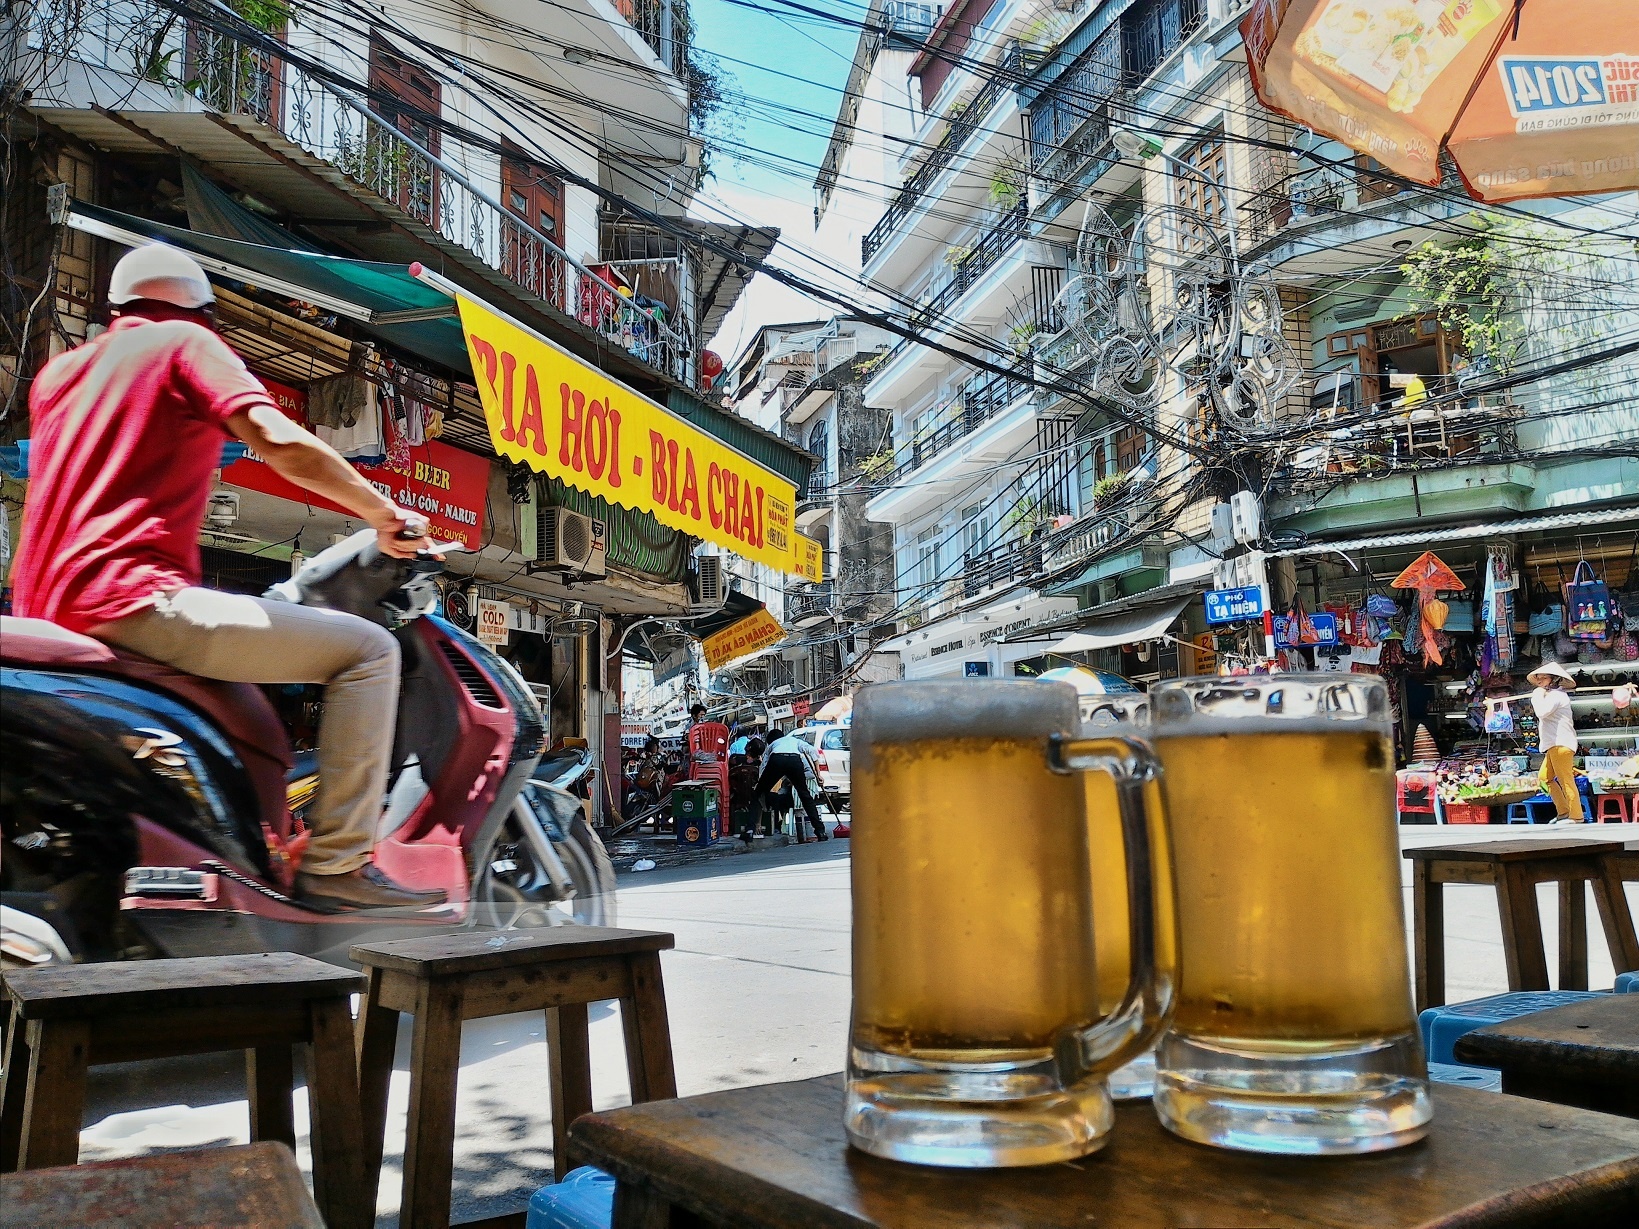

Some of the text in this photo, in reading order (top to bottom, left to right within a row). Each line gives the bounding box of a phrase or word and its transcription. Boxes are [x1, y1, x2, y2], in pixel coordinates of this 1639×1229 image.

[559, 381, 622, 489] HƠI
[648, 427, 702, 522] BIA
[707, 461, 764, 550] CHAI
[413, 460, 451, 491] BEER
[367, 478, 392, 500] GER
[417, 494, 440, 515] GÒN
[444, 503, 478, 526] NARUE
[443, 528, 468, 544] QUYẾN
[1224, 590, 1244, 602] PHỐ
[1213, 600, 1258, 618] TẠ HIỆN
[483, 610, 505, 626] COLD
[979, 626, 1003, 642] ESSENCE
[1317, 625, 1334, 641] UYẾN
[621, 724, 652, 735] MOTORBIKES
